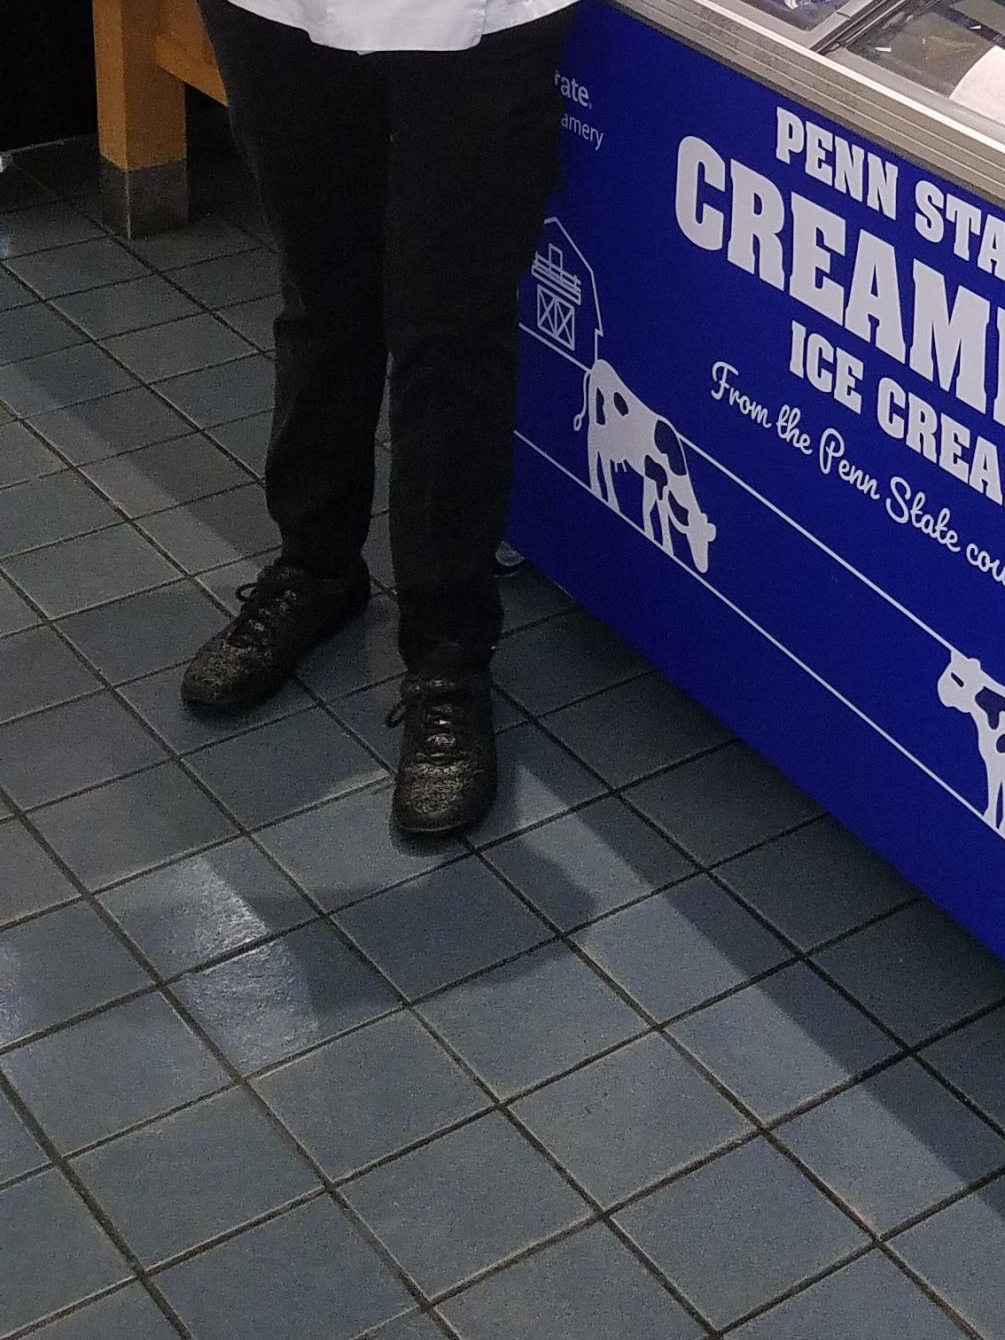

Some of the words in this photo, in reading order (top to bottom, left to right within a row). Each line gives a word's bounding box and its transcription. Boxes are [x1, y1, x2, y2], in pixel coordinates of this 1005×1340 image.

[561, 113, 604, 151] amery
[776, 106, 898, 220] PENN
[790, 320, 864, 414] ICE
[711, 361, 772, 428] From
[775, 403, 813, 456] the
[819, 427, 880, 501] Penn
[886, 476, 961, 552] State
